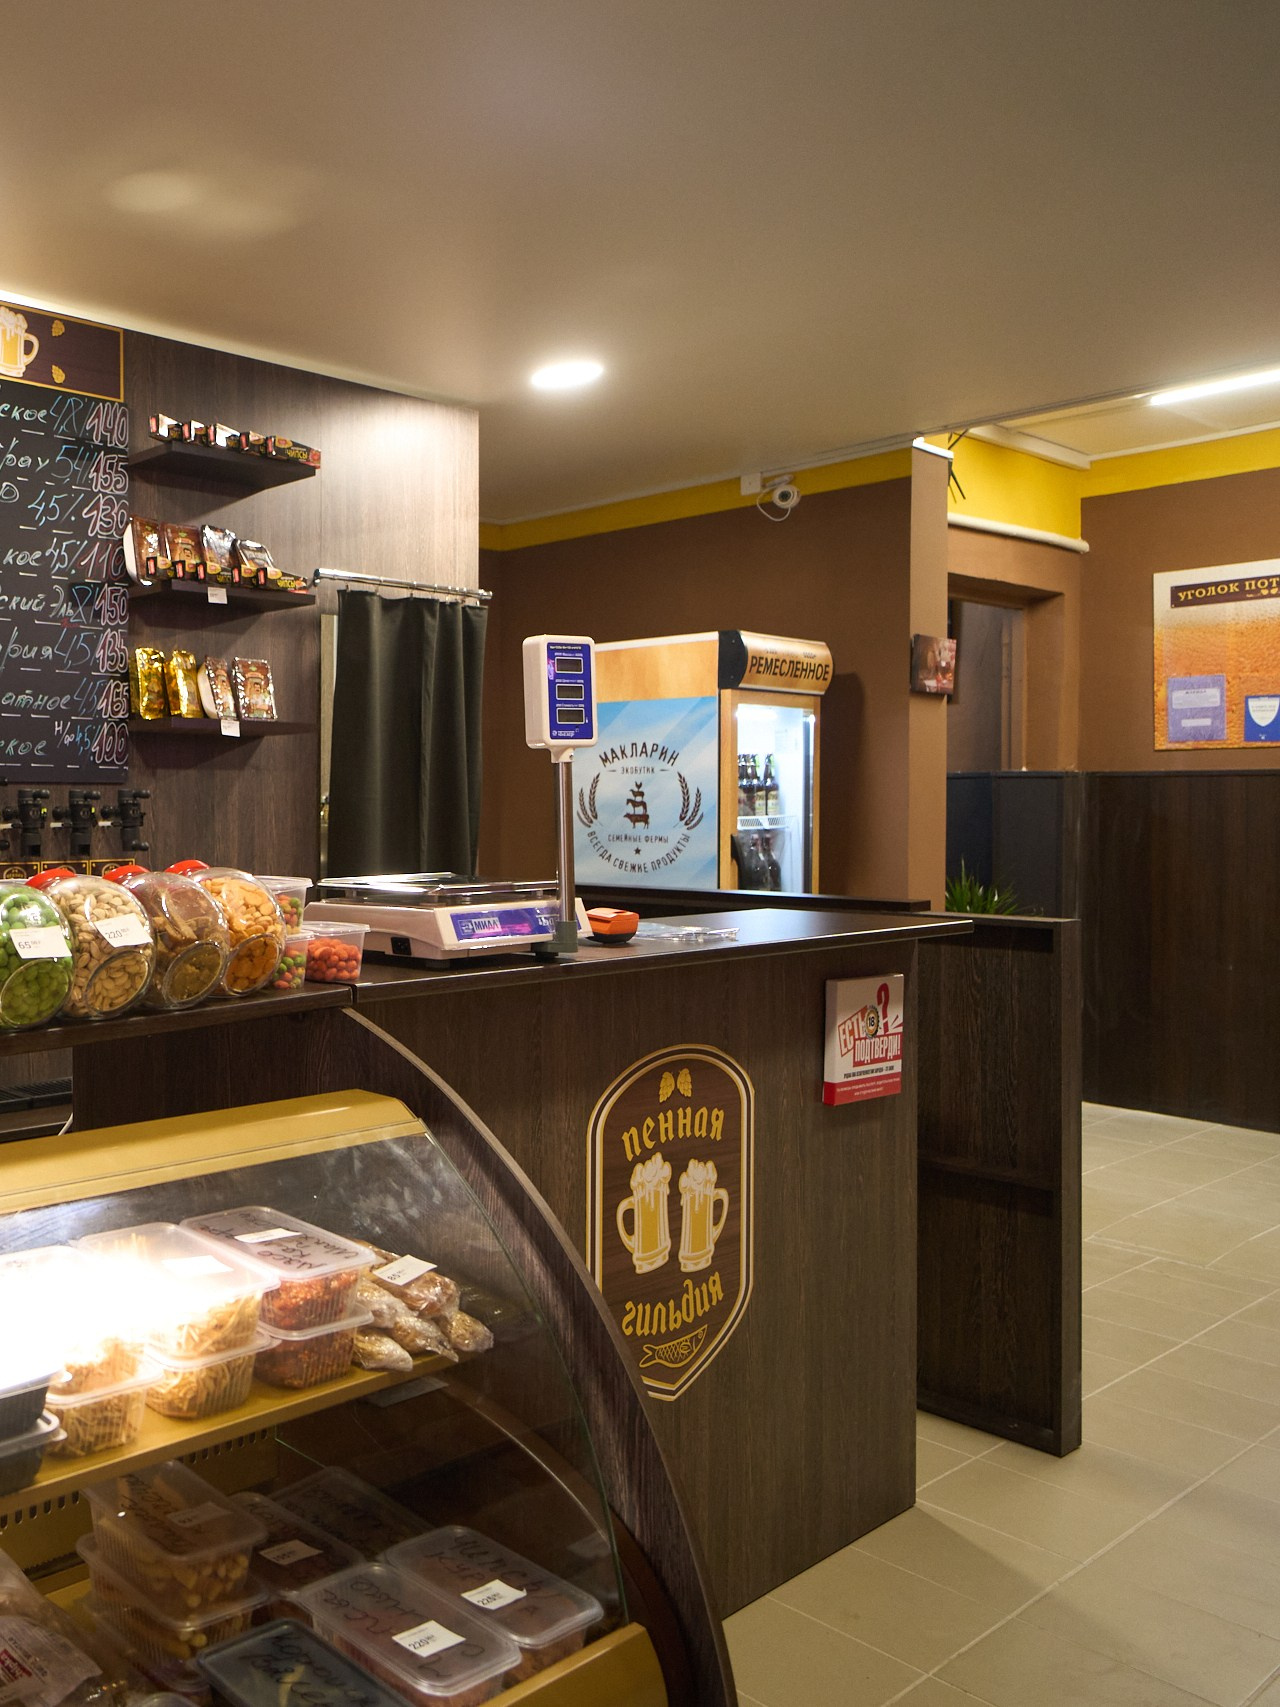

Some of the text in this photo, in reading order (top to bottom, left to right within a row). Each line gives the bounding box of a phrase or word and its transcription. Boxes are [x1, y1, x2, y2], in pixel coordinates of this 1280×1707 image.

[85, 402, 129, 448] 140
[88, 450, 129, 494] 155
[94, 583, 129, 625] 150
[1177, 582, 1239, 601] УГОЛОК
[748, 655, 830, 681] РЕМЕСЛЕННОЕ
[598, 742, 680, 768] МАКЛАРИН
[621, 766, 655, 775] ЭКОБУТИК
[587, 830, 691, 873] ВСЕГДА СВЕЖИЕ ПРОДУКТЫ
[607, 834, 669, 844] СЕМЕЙНЫЕ ФЕРМЫ
[854, 1033, 901, 1064] ПОДТВЕРДИ!
[621, 1105, 725, 1163] пенная
[621, 1271, 725, 1337] гильдия
